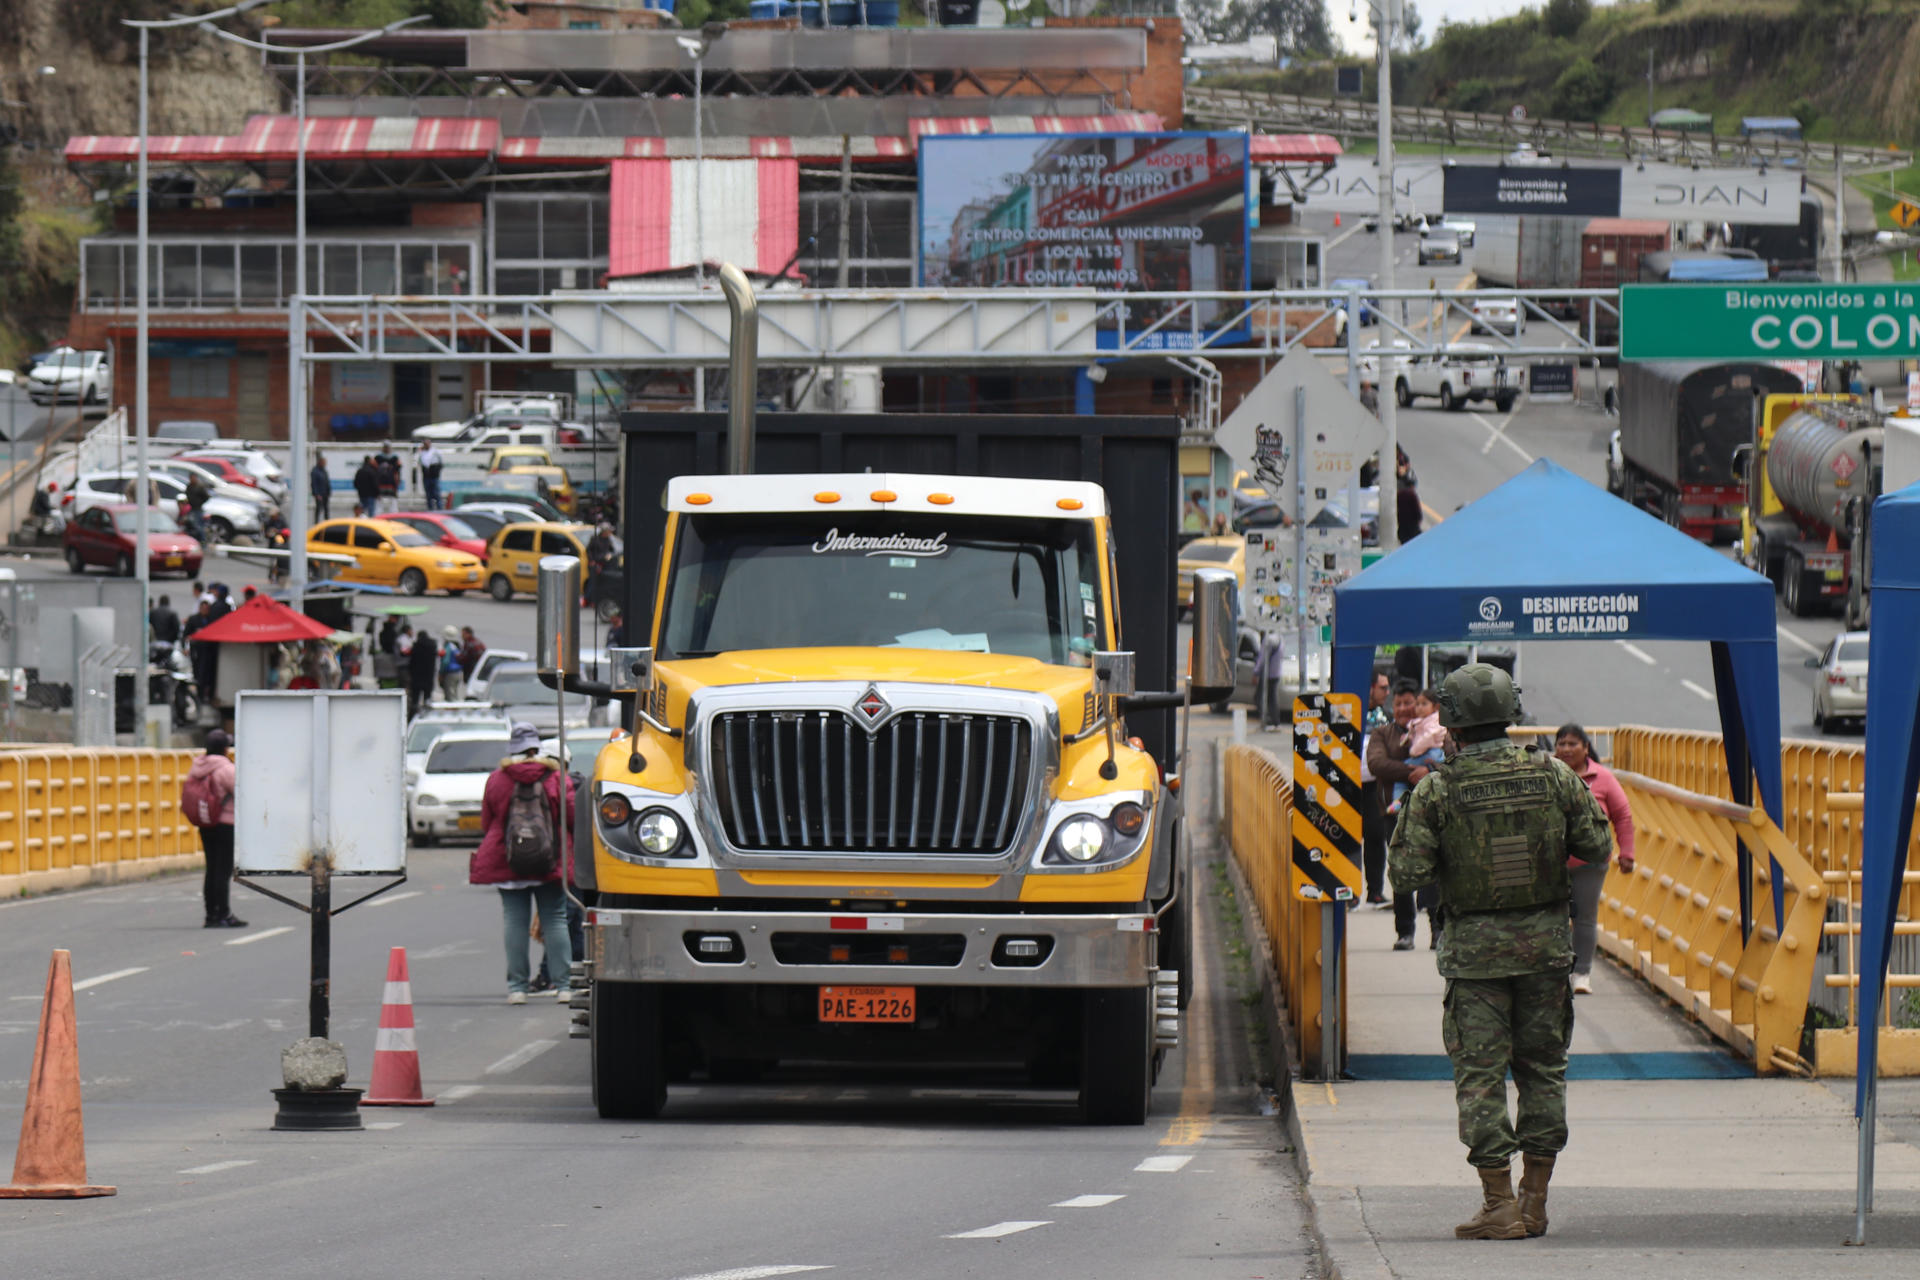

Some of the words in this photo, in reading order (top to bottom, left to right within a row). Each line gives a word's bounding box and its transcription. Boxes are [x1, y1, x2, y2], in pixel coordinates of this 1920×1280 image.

[1058, 154, 1107, 168] PASTO
[1145, 153, 1231, 168] MODERNO
[1101, 172, 1164, 186] CENTRO
[1499, 178, 1559, 190] Bienvenidos
[1560, 182, 1568, 190] a
[1498, 191, 1568, 202] COLOMBIA
[1655, 185, 1768, 206] DIAN
[964, 227, 1024, 241] CENTRO
[1027, 227, 1113, 241] COMERCIAL
[1117, 226, 1203, 240] UNICENTRO
[1044, 245, 1092, 258] LOCAL
[1025, 268, 1138, 283] CONTACTANOS
[1726, 290, 1865, 309] Bienvenidos
[1873, 294, 1886, 308] a
[1895, 290, 1914, 308] la
[811, 527, 949, 557] International
[1522, 593, 1639, 614] DESINFECCIÓN
[1533, 617, 1554, 633] DE
[1556, 615, 1630, 633] CALZADO
[823, 999, 912, 1018] PAE-1226
